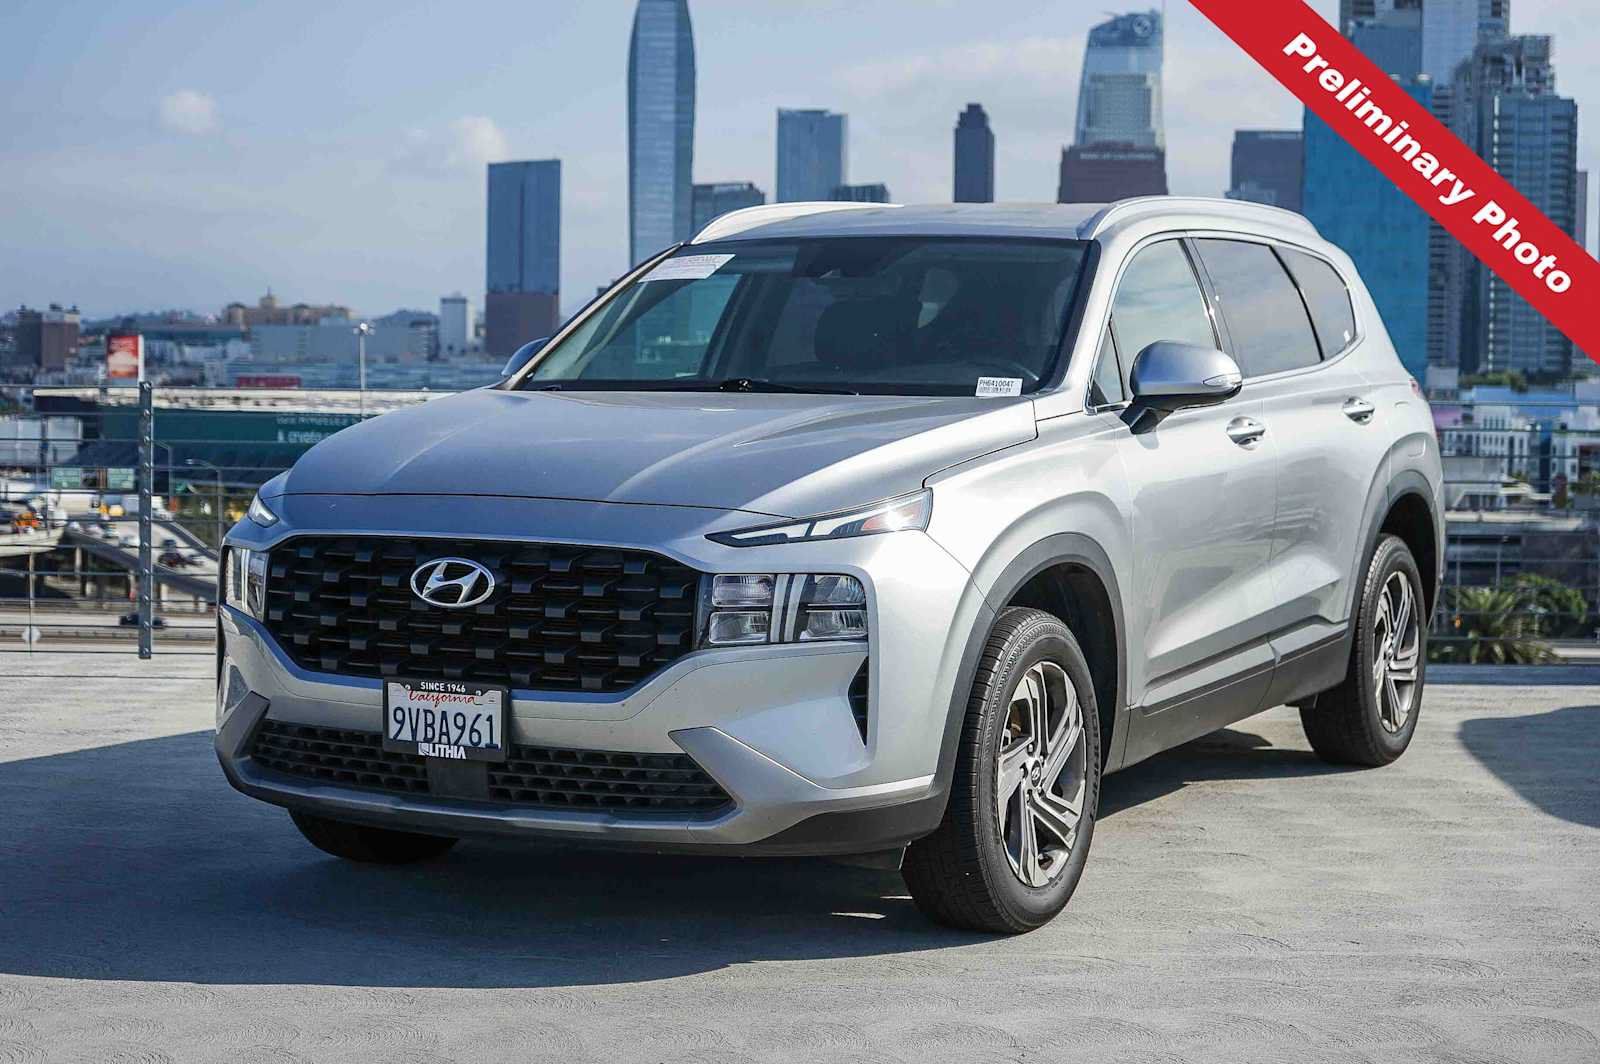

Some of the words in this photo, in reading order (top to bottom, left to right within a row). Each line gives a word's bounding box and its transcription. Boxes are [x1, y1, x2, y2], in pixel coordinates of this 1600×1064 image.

[420, 681, 445, 692] SINCE
[447, 683, 466, 693] 1946
[408, 688, 483, 708] California
[392, 706, 499, 749] 9VBA961
[429, 743, 467, 760] LITHIA
